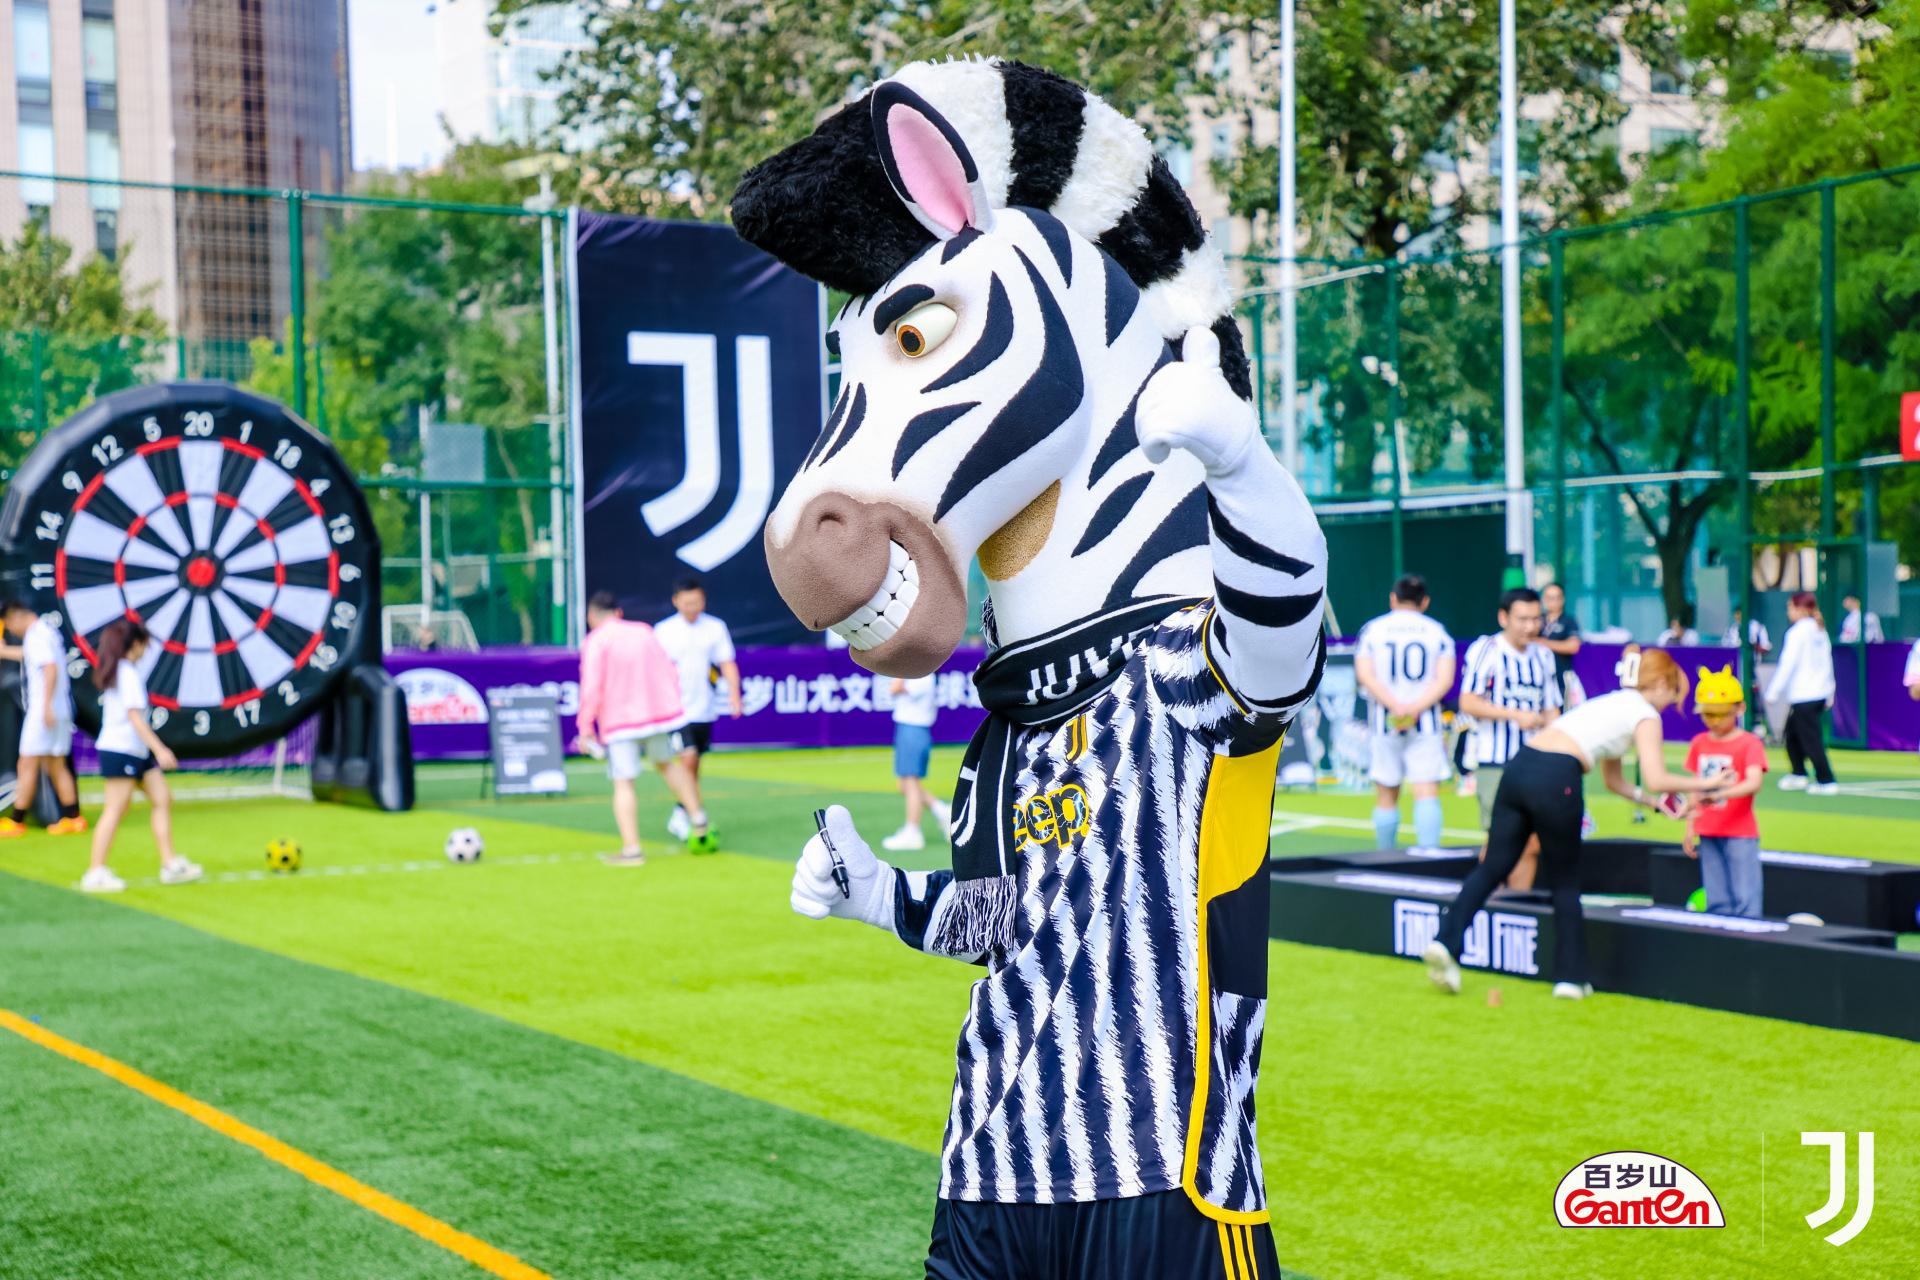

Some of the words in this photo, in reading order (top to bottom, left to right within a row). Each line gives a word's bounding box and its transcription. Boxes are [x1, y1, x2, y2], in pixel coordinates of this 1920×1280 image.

[143, 416, 162, 443] 5
[183, 410, 214, 437] 20
[239, 420, 254, 444] 1
[91, 434, 124, 466] 12
[273, 438, 302, 469] 18
[62, 470, 84, 494] 9
[310, 478, 331, 497] 4
[35, 509, 64, 541] 14
[328, 512, 356, 544] 13
[30, 563, 56, 591] 11
[331, 601, 357, 630] 10
[1384, 641, 1427, 681] 10
[278, 680, 300, 706] 2
[194, 709, 211, 736] 3
[233, 699, 262, 729] 17
[1492, 912, 1539, 975] FINE
